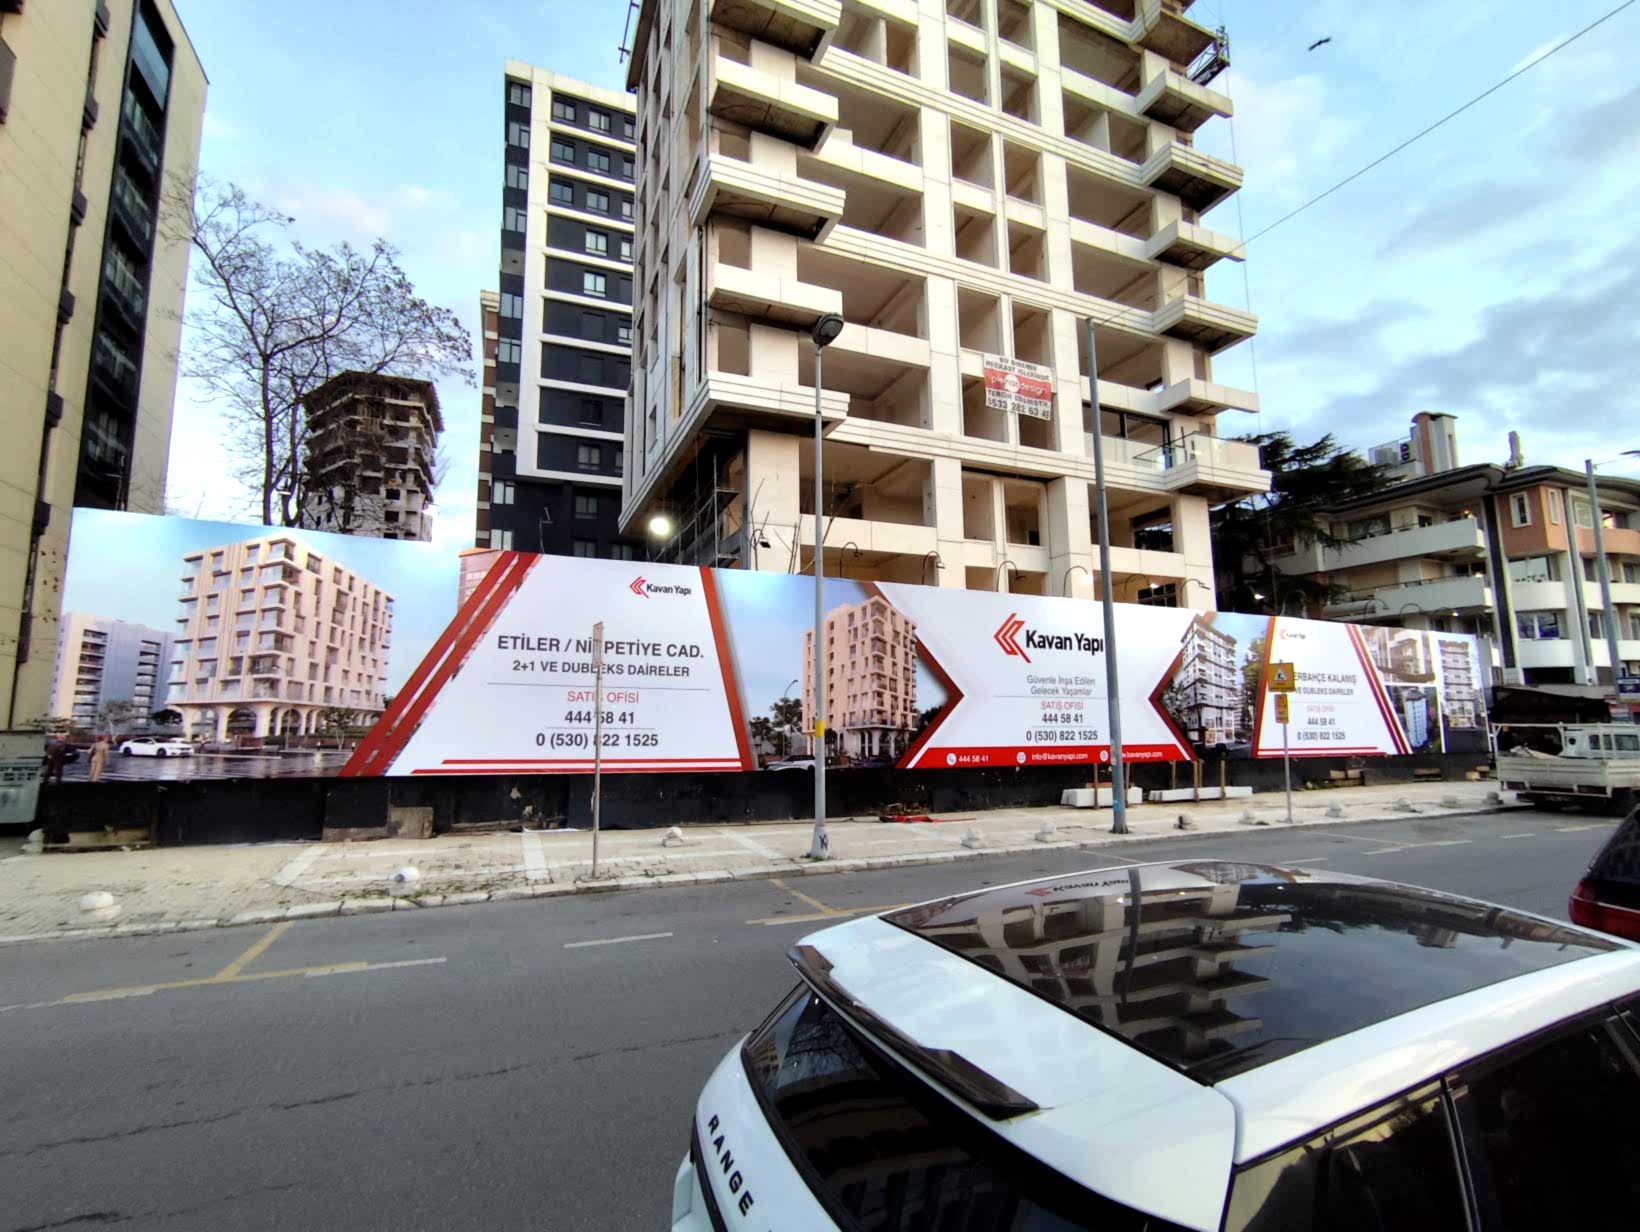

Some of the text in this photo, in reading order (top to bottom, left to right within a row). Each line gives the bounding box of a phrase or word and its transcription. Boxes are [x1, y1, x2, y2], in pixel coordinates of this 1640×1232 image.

[646, 584, 673, 594] Kavan
[498, 633, 704, 658] ETİLER / NİPETİYE CAD.
[1026, 629, 1104, 656] Kavan Yapı
[513, 660, 535, 672] 2+1
[540, 661, 558, 672] VE
[628, 663, 690, 676] DAİRELER
[1026, 674, 1056, 684] Güvenle
[1074, 676, 1096, 686] Edilen
[607, 691, 639, 703] OFİSİ
[1030, 686, 1093, 697] Gelecek Yaşamlar
[565, 710, 592, 723] 444
[618, 711, 634, 724] 41
[1042, 713, 1083, 723] 444 58 41
[536, 733, 545, 746] 0
[550, 733, 588, 749] (530)
[625, 734, 659, 747] 1525
[1026, 730, 1098, 743] 0 (530) 822 1525
[1032, 752, 1088, 761] info@kavanyapi.com
[708, 1114, 754, 1217] RANGE
